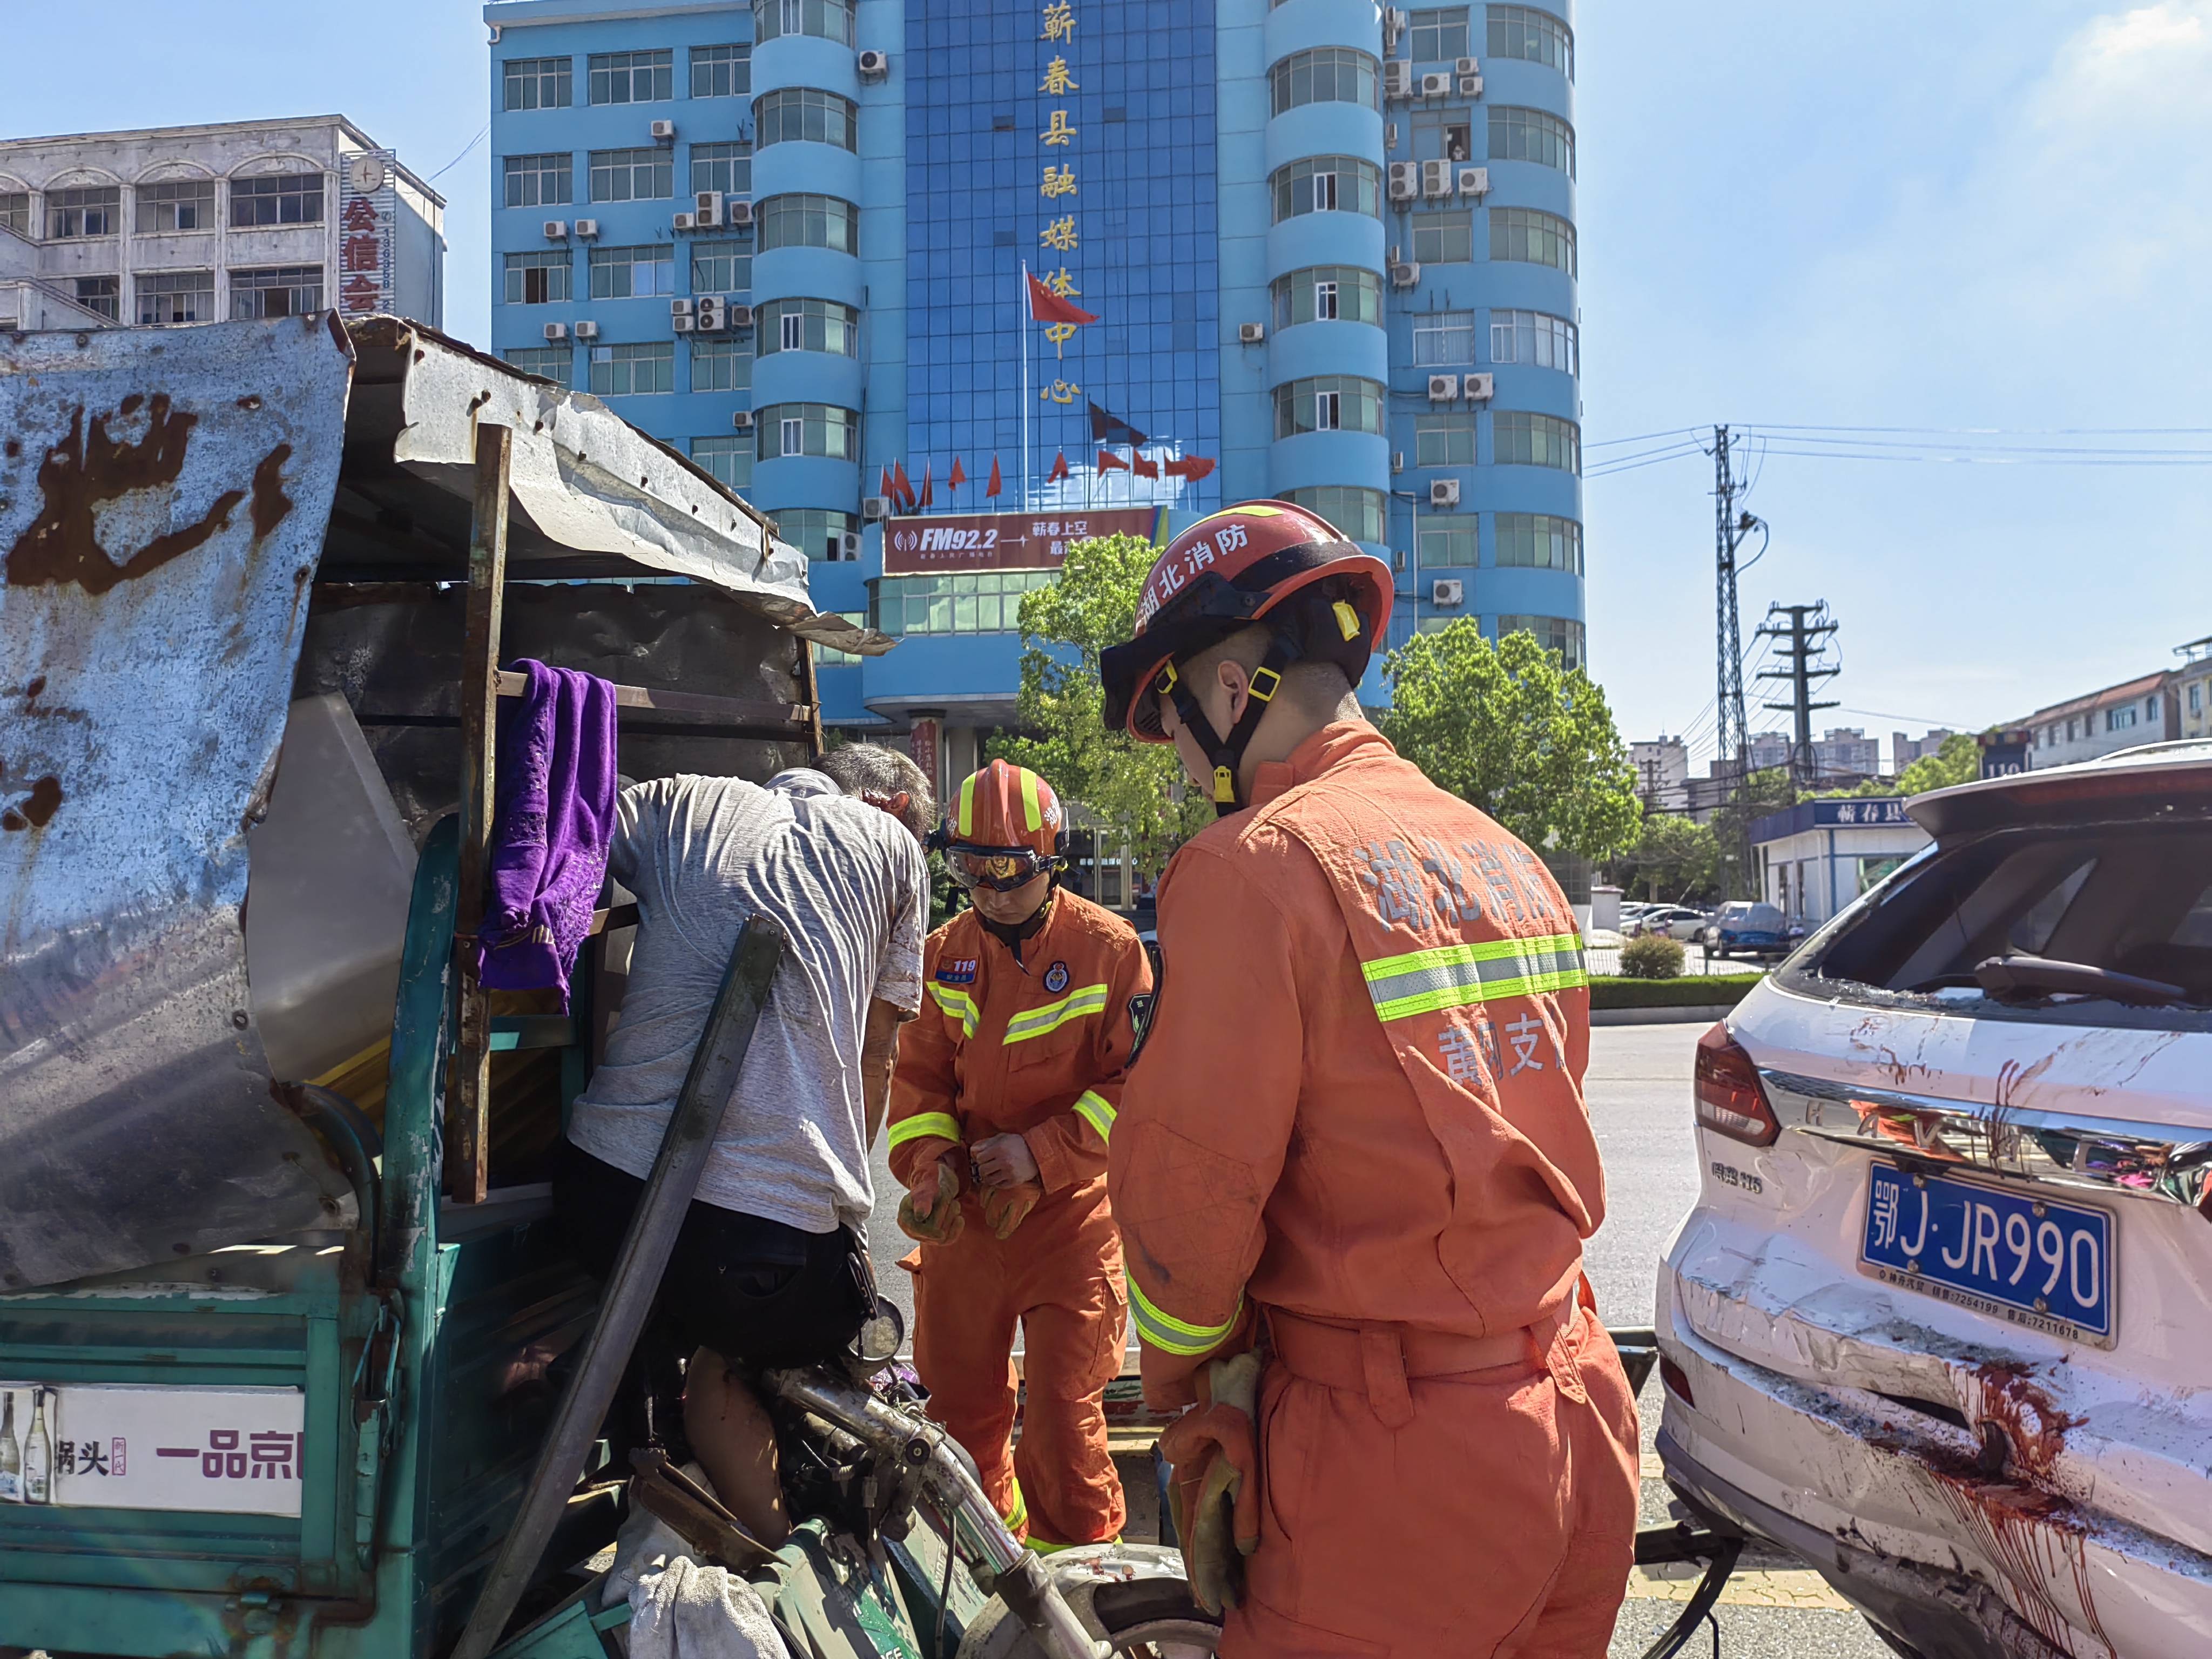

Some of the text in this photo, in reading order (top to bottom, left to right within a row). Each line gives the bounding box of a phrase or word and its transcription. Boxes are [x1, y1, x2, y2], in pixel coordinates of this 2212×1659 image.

[1037, 0, 1081, 404] 蕲春县融媒体中心
[920, 527, 999, 551] FM92.2
[1032, 521, 1088, 537] 蕲春上空
[1142, 523, 1249, 621] 湖北消防
[1354, 837, 1556, 933] 湖北消防
[954, 960, 976, 972] 119
[1438, 1011, 1565, 1087] 黄冈支
[156, 1429, 304, 1480] 一品京
